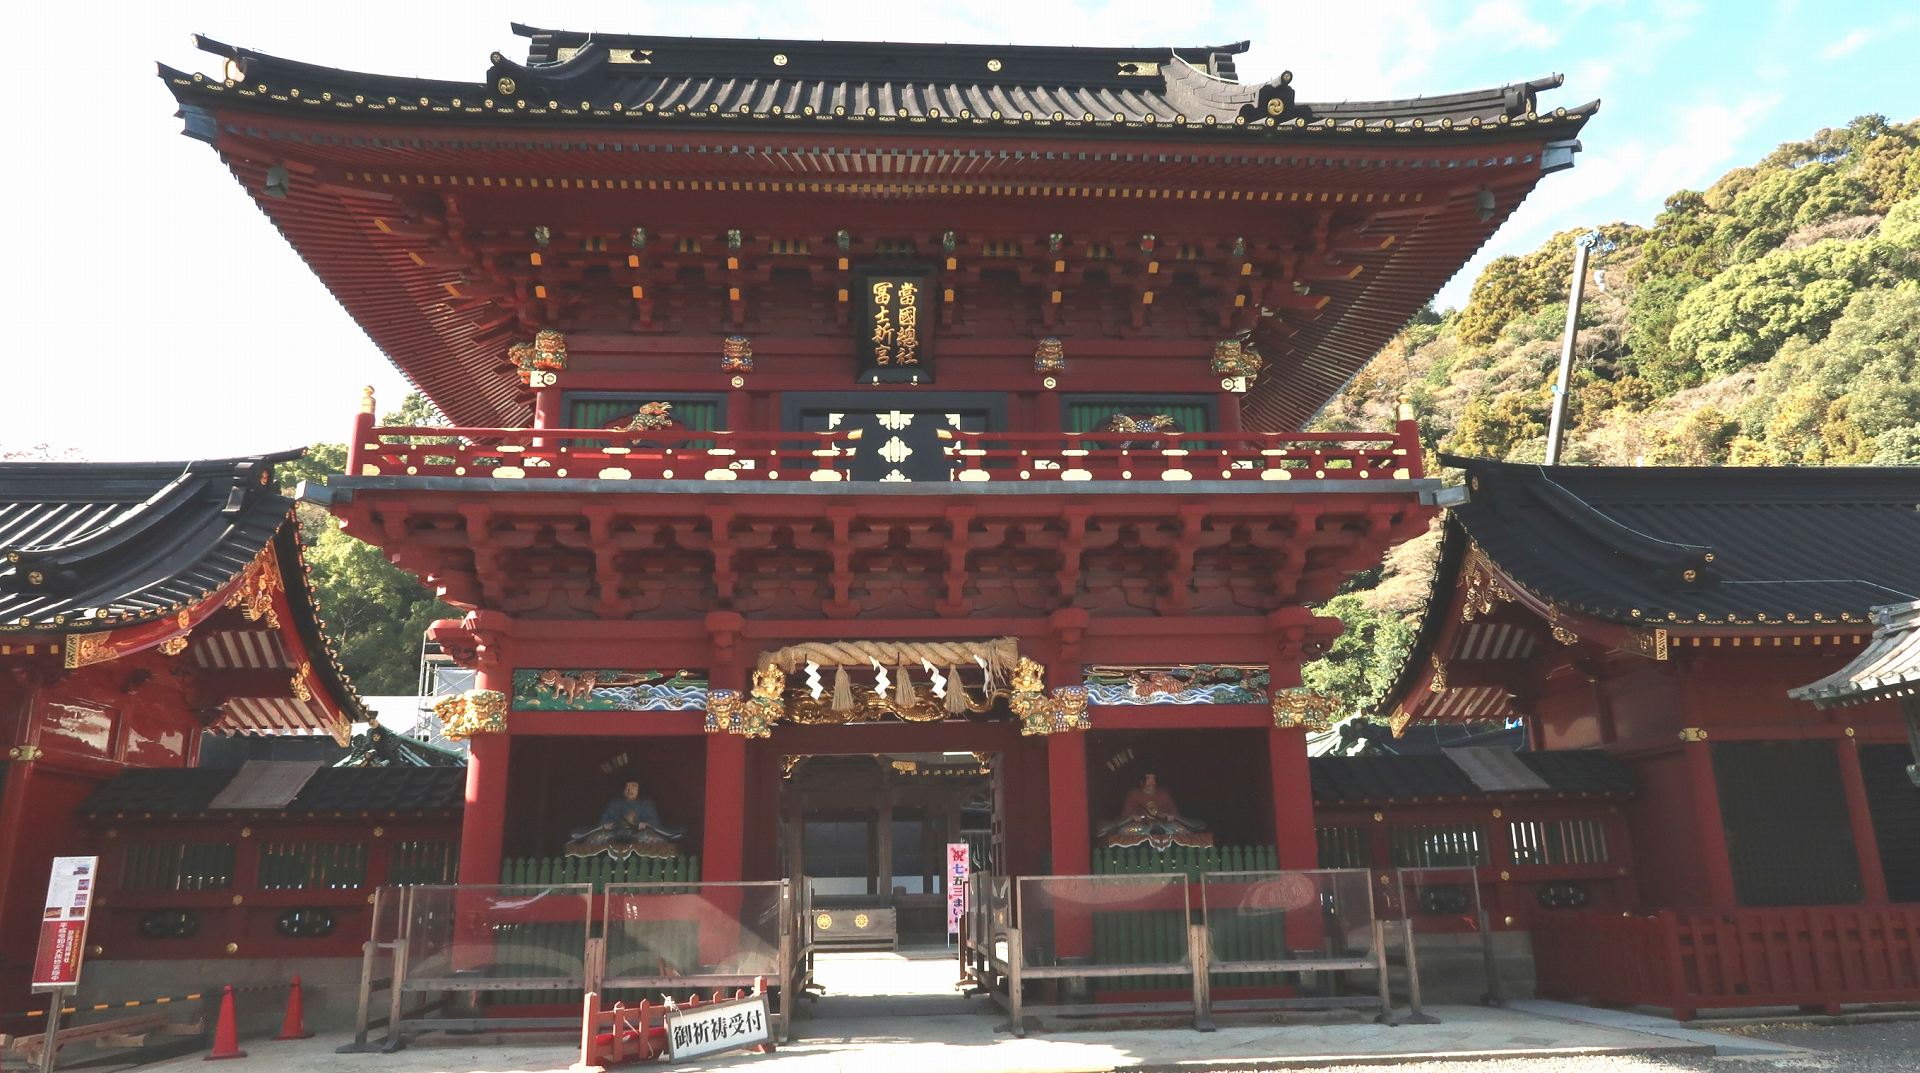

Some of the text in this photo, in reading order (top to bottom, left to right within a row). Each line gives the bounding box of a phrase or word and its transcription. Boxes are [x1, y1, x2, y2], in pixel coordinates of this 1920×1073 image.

[896, 282, 919, 365] 當國總社
[674, 1010, 762, 1049] 御祈祷受付
